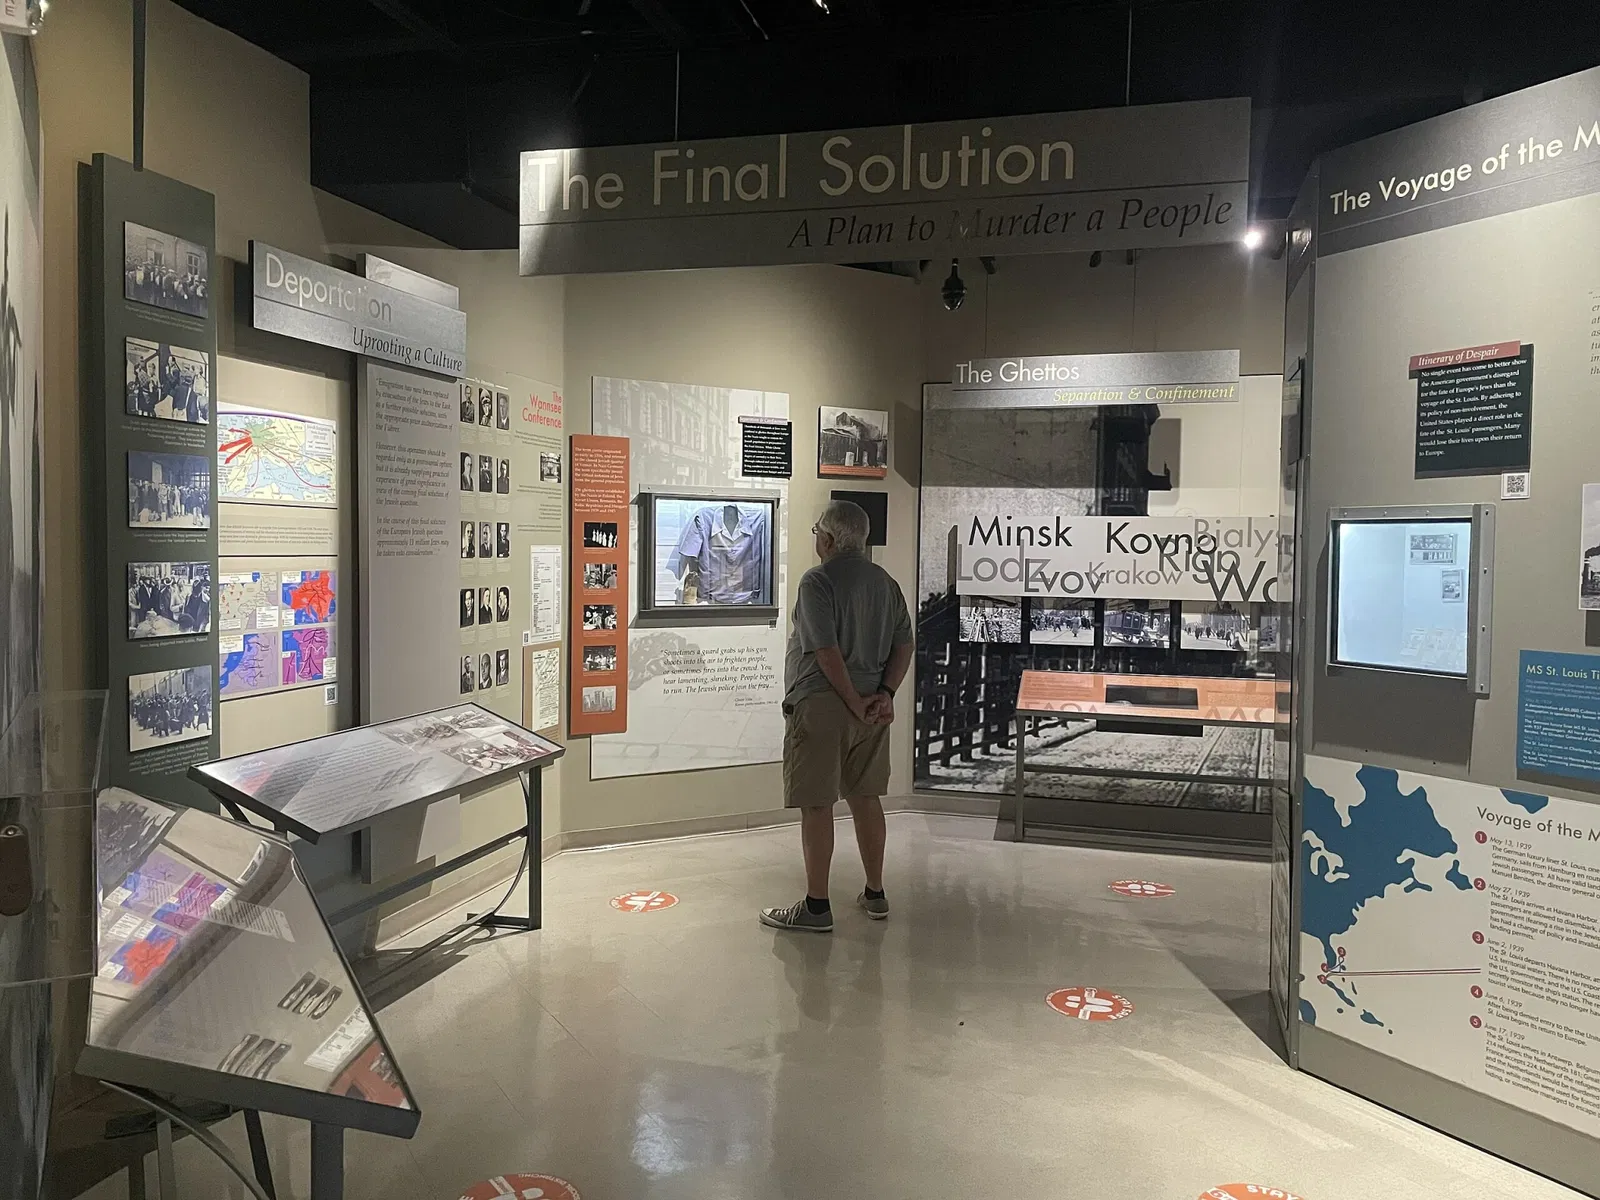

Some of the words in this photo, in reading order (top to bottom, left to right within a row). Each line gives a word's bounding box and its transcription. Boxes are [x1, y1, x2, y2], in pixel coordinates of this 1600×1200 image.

[527, 150, 624, 212] The
[653, 134, 787, 205] Final
[819, 125, 1074, 196] Solution
[1330, 189, 1371, 214] The
[1378, 163, 1472, 201] Voyage
[1481, 143, 1510, 175] of
[1518, 137, 1563, 166] the
[787, 219, 812, 248] A
[825, 215, 893, 246] Plan
[907, 218, 935, 241] to
[1086, 209, 1105, 231] a
[1118, 193, 1233, 237] People
[266, 252, 391, 323] Deportaon
[352, 326, 412, 364] Uprooting
[414, 349, 421, 362] a
[423, 347, 463, 372] Culture
[1418, 354, 1453, 366] Itinerary
[1456, 351, 1466, 363] of
[1466, 347, 1500, 361] Despair
[956, 362, 992, 384] The
[999, 359, 1080, 382] Ghettos
[1430, 368, 1445, 377] single
[1492, 369, 1519, 379] disregard
[530, 394, 562, 414] Wannsee
[552, 392, 562, 403] The
[1053, 388, 1123, 403] Separation
[1128, 387, 1141, 400] &
[1145, 386, 1235, 401] Confinement
[1480, 394, 1487, 402] By
[1488, 391, 1514, 399] adhering
[522, 408, 562, 428] Conference
[1426, 409, 1442, 418] policy
[1454, 416, 1472, 425] played
[968, 516, 1073, 547] Minsk
[1106, 522, 1217, 554] Kovno
[1194, 516, 1279, 558] Bialy
[958, 539, 1051, 582] Lodz
[1024, 558, 1106, 594] Lvov
[1088, 559, 1184, 586] Krakow
[700, 648, 719, 656] guard
[719, 647, 736, 656] grabs
[1526, 664, 1542, 675] MS
[1546, 666, 1558, 676] St.
[1562, 668, 1588, 679] Louis
[1477, 806, 1532, 830] Voyage
[1536, 820, 1552, 833] of
[1557, 822, 1582, 839] the
[1490, 836, 1503, 846] May
[1504, 838, 1513, 848] 13,
[1516, 840, 1532, 850] 1939
[1488, 884, 1501, 894] May
[1515, 888, 1530, 898] 1939
